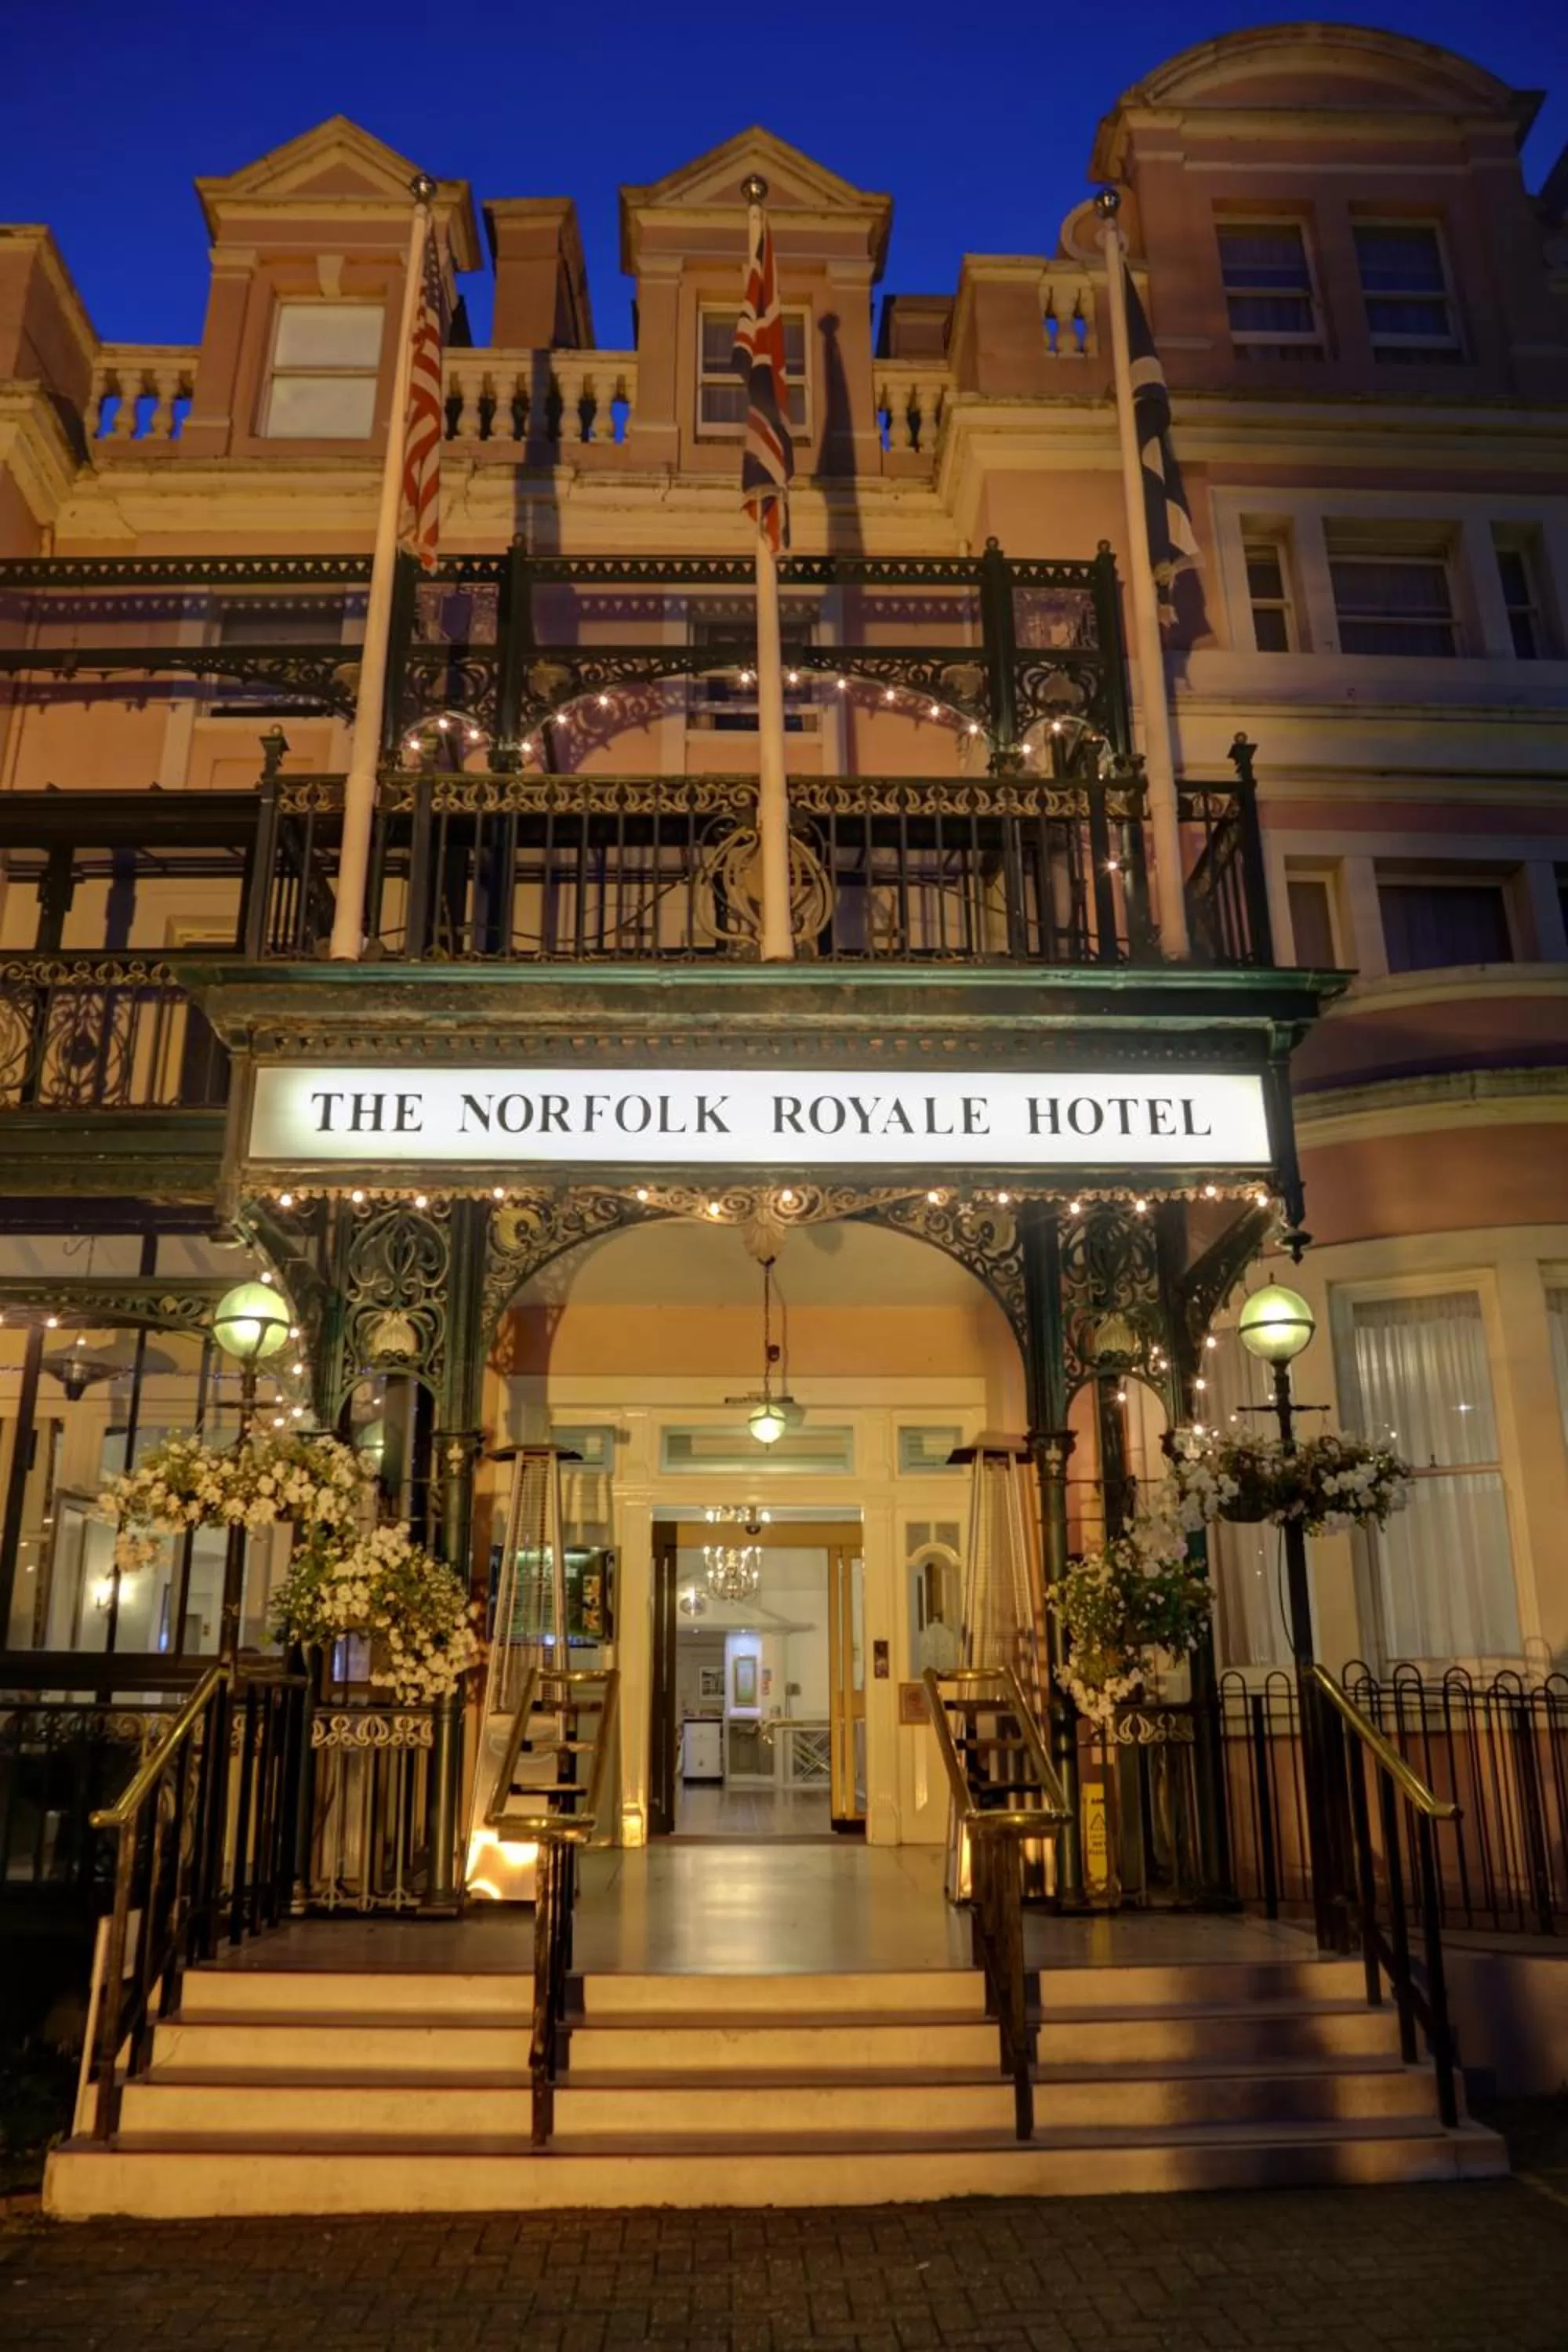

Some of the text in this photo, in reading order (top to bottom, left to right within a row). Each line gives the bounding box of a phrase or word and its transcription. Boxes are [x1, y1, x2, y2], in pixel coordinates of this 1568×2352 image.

[312, 1092, 1212, 1136] THE NORFOLK ROYALE HOTEL
